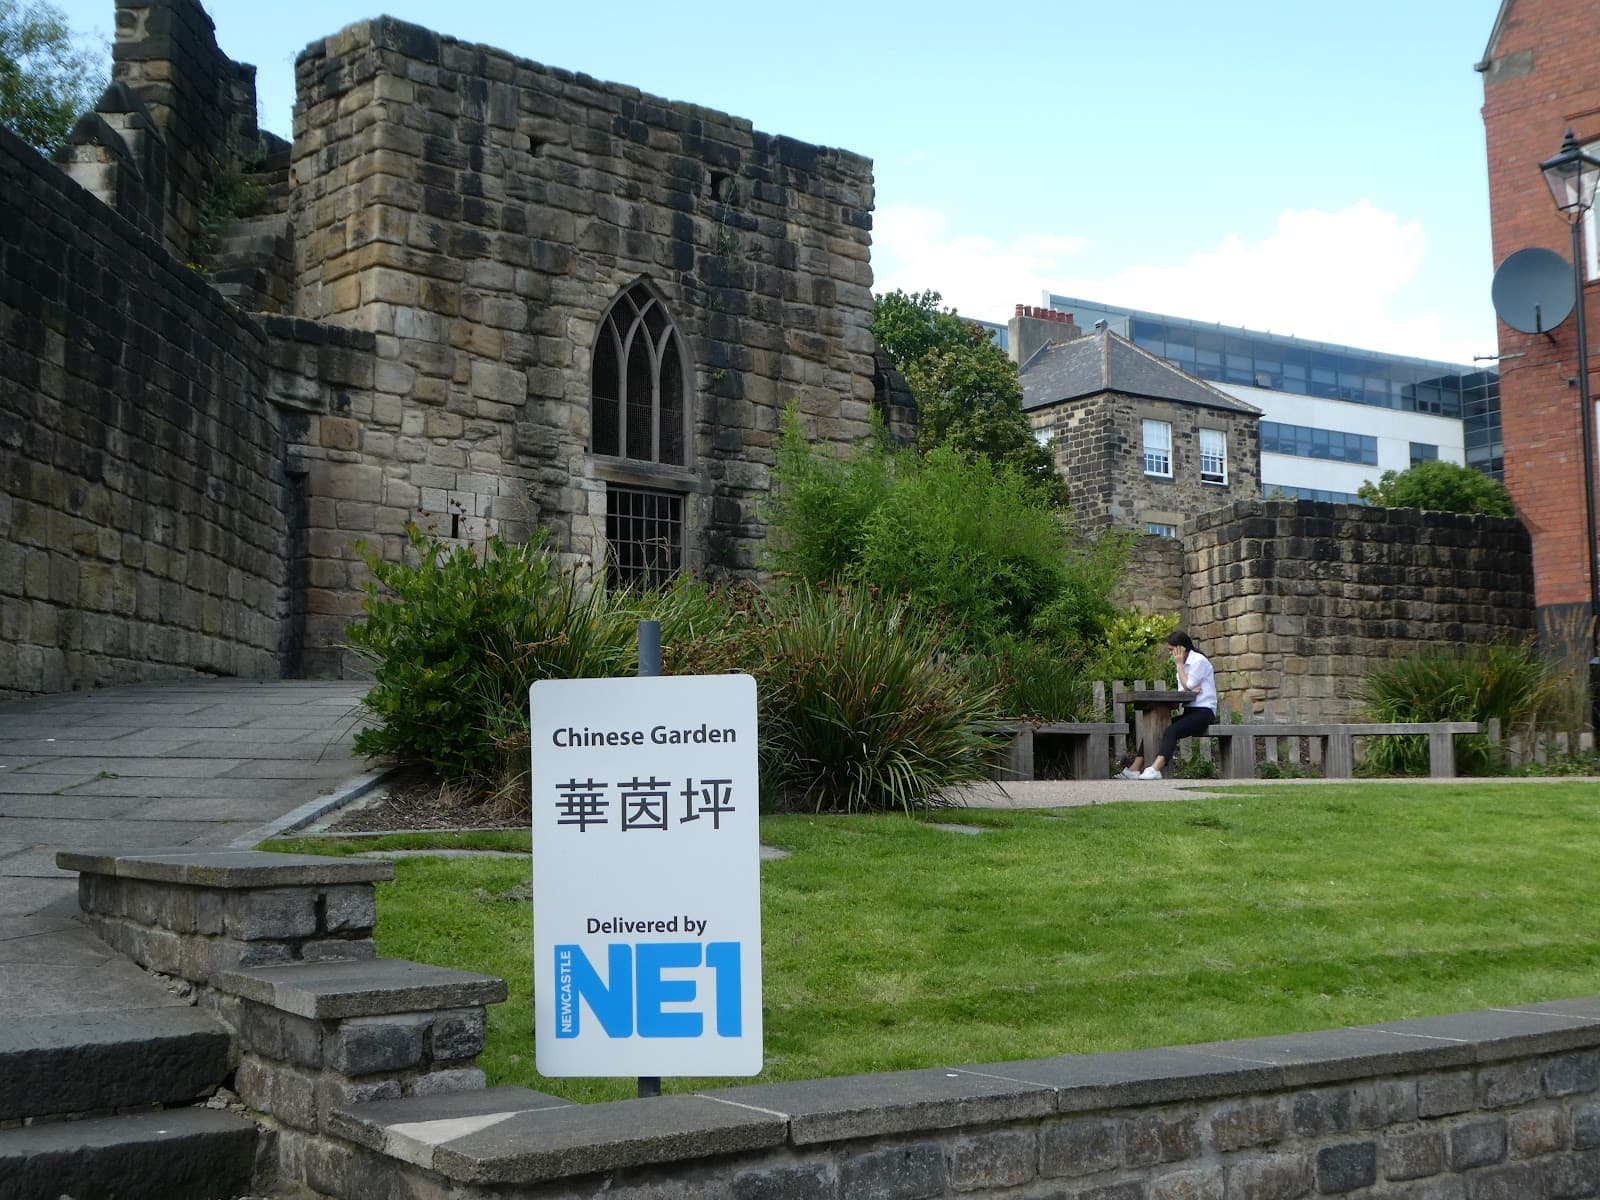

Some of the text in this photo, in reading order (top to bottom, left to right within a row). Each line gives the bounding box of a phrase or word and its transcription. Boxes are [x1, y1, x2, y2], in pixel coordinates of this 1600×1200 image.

[552, 723, 737, 748] Chinese Garden
[554, 775, 736, 833] 華茵坪
[586, 915, 708, 937] Delivered by
[553, 941, 743, 1040] NE1
[560, 950, 572, 1033] NEWCASTLE
